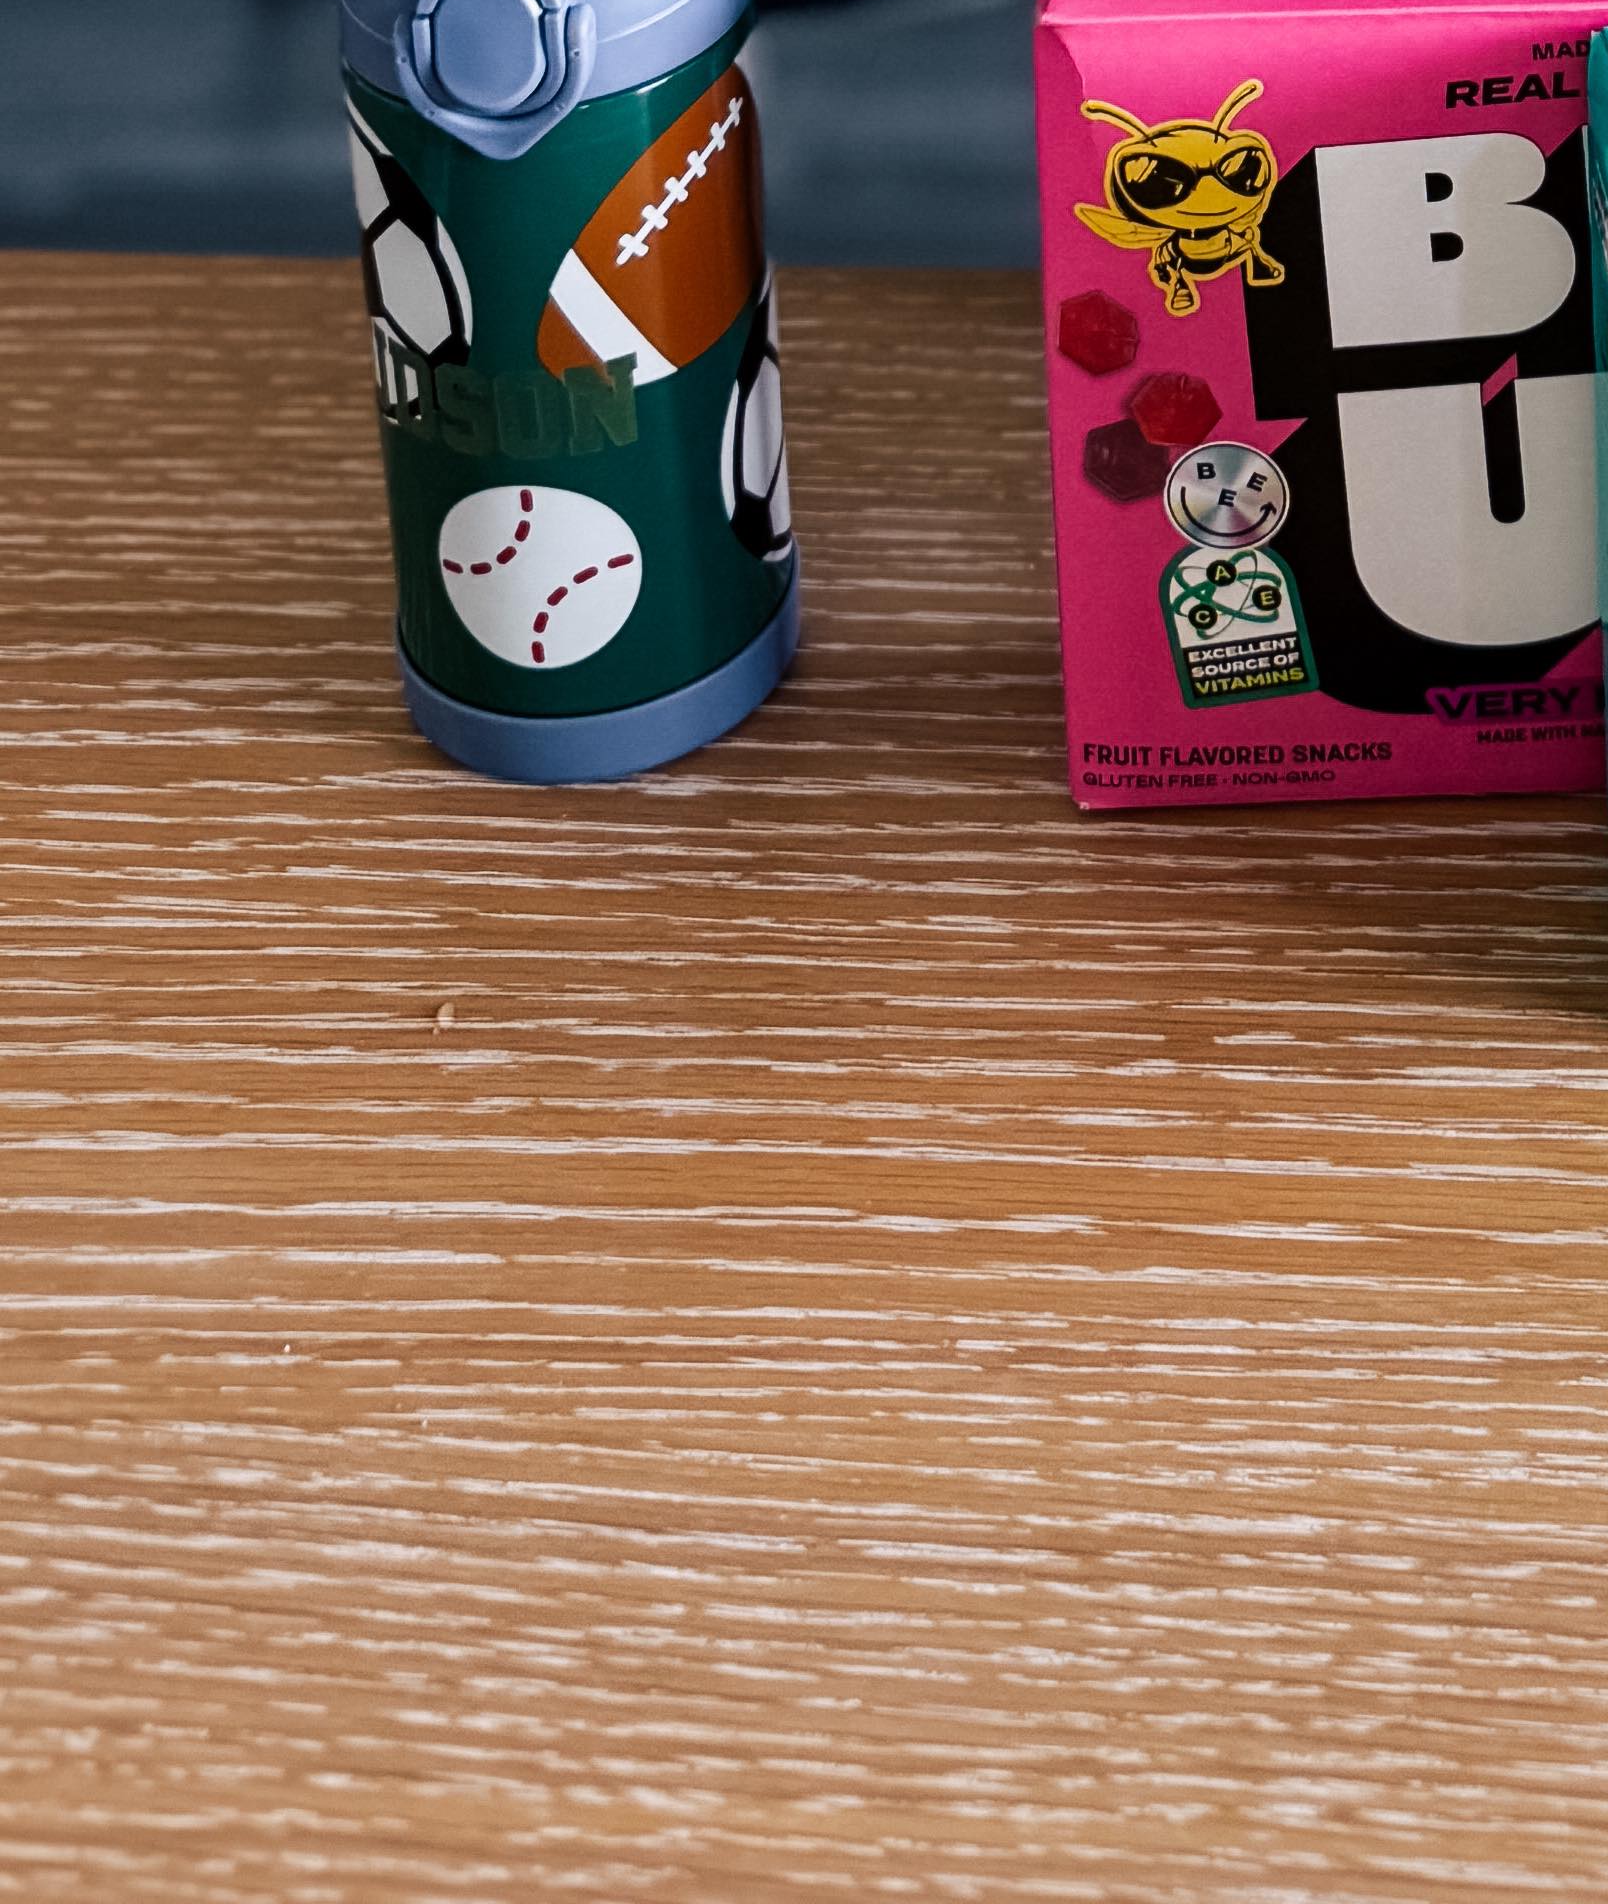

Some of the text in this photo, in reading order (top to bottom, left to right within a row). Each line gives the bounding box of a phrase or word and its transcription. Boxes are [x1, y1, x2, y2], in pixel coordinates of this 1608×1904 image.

[1532, 40, 1591, 60] MAD
[1446, 72, 1581, 109] REAL
[1337, 372, 1598, 647] U
[1188, 637, 1297, 663] EXCELLENT
[1191, 652, 1300, 679] SOURCE OF
[1194, 666, 1305, 694] VITAMINS
[1435, 687, 1581, 719] VERY
[1476, 727, 1526, 743] MADE
[1083, 741, 1393, 768] FRUIT FLAVORED SNACKS
[1082, 769, 1336, 789] GLUTEN FREE NON-GMO
